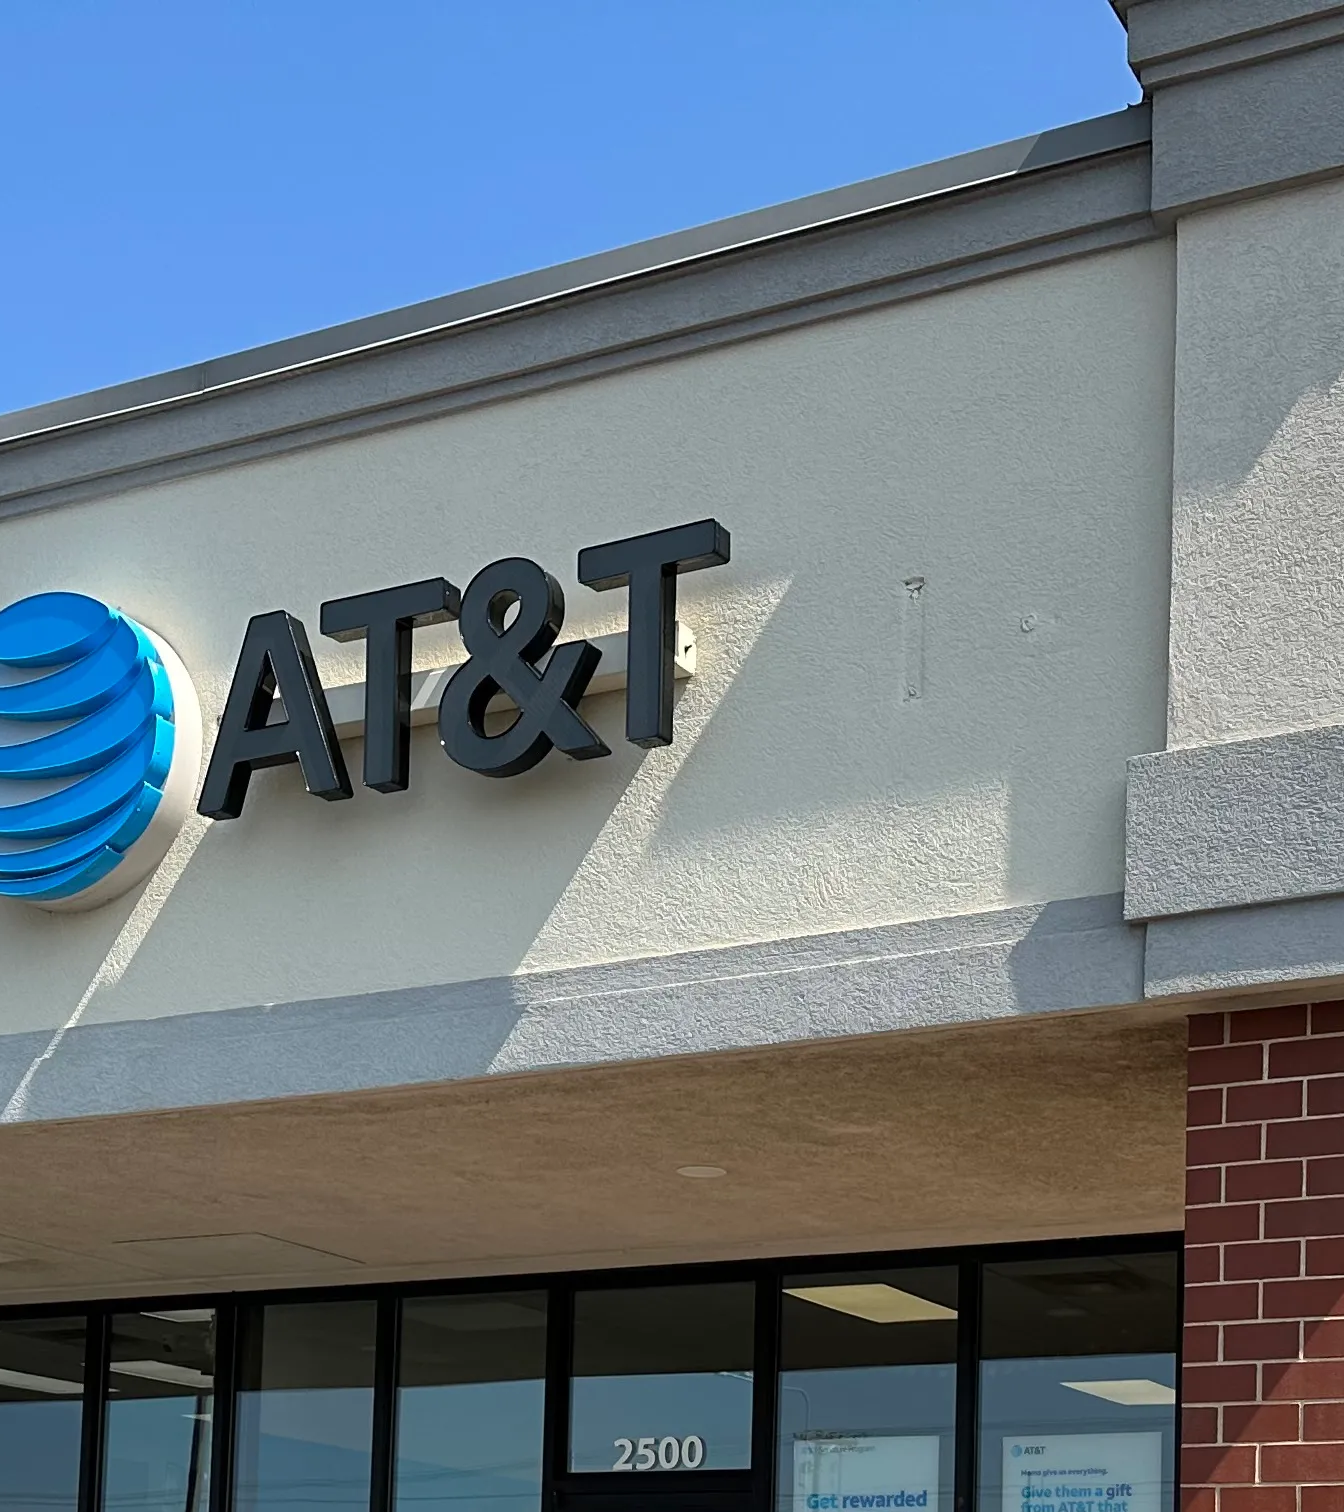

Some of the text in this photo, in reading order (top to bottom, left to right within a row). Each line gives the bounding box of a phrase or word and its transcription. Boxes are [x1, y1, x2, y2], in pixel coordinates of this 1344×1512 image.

[198, 517, 732, 820] AT&T
[613, 1436, 707, 1471] 2500
[1023, 1446, 1047, 1455] AT&T
[806, 1490, 928, 1509] Get rewarded
[1021, 1483, 1133, 1500] Give them a gift
[1097, 1500, 1128, 1512] that
